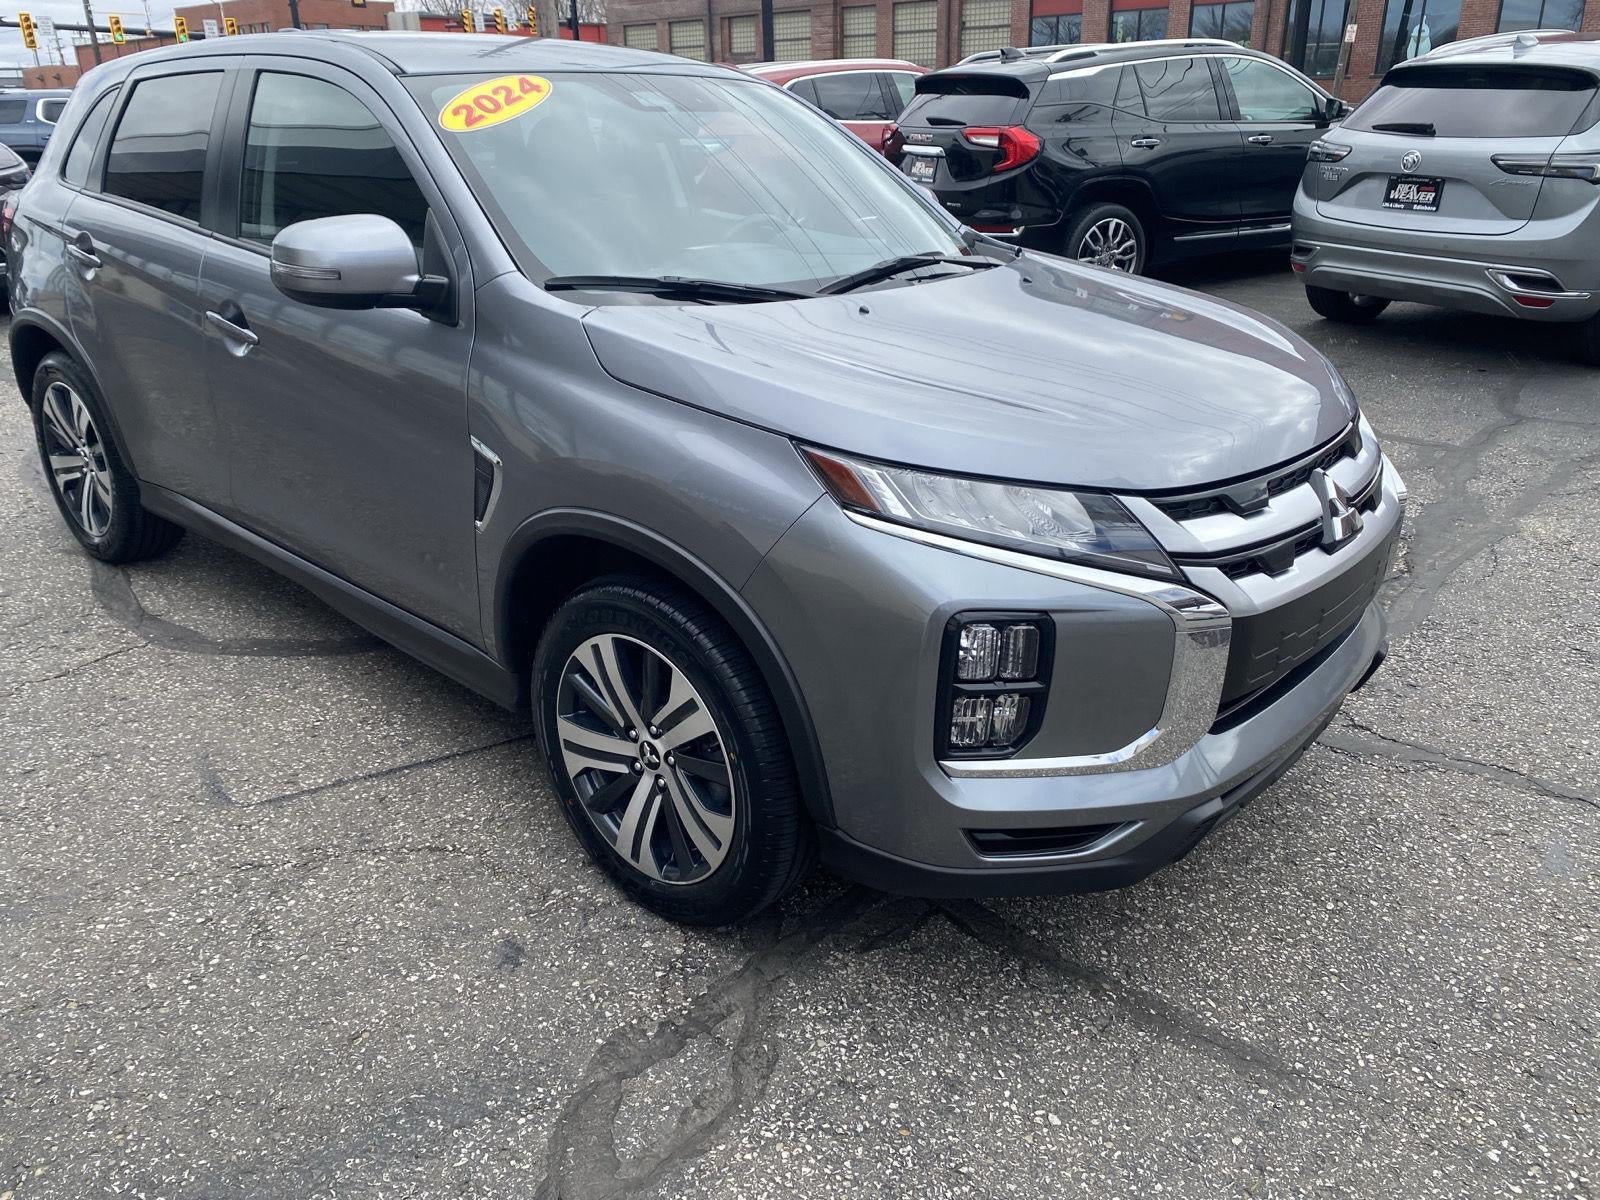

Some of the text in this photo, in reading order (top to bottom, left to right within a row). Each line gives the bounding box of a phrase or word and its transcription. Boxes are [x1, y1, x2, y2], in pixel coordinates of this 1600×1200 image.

[451, 77, 542, 127] 2024
[910, 133, 933, 142] GMC
[1397, 183, 1419, 192] RICK
[1390, 190, 1436, 202] WEAVER
